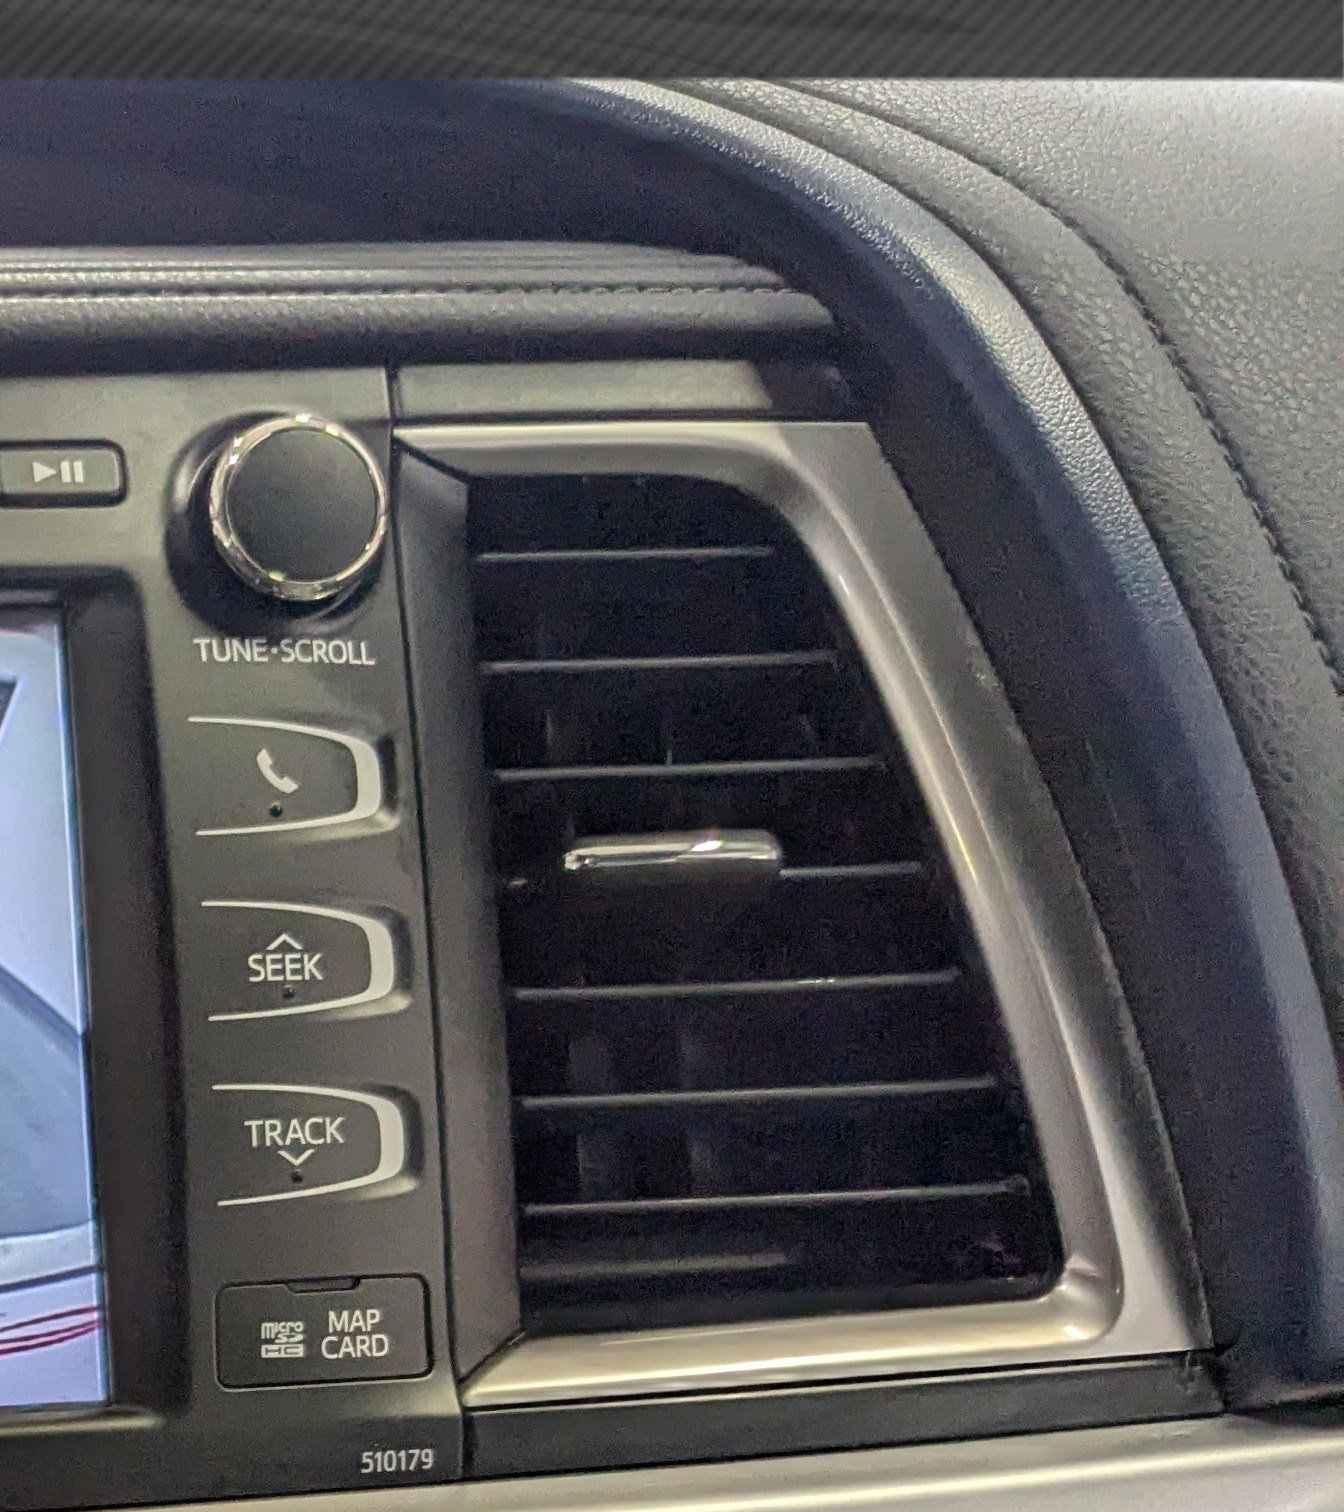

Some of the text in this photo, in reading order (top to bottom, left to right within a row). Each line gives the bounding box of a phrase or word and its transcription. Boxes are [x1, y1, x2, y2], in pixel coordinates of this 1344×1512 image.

[247, 953, 324, 983] SEEK
[244, 1116, 346, 1148] TRACK
[328, 1308, 381, 1334] MAP
[321, 1333, 389, 1360] CARD
[361, 1448, 435, 1474] 510179
